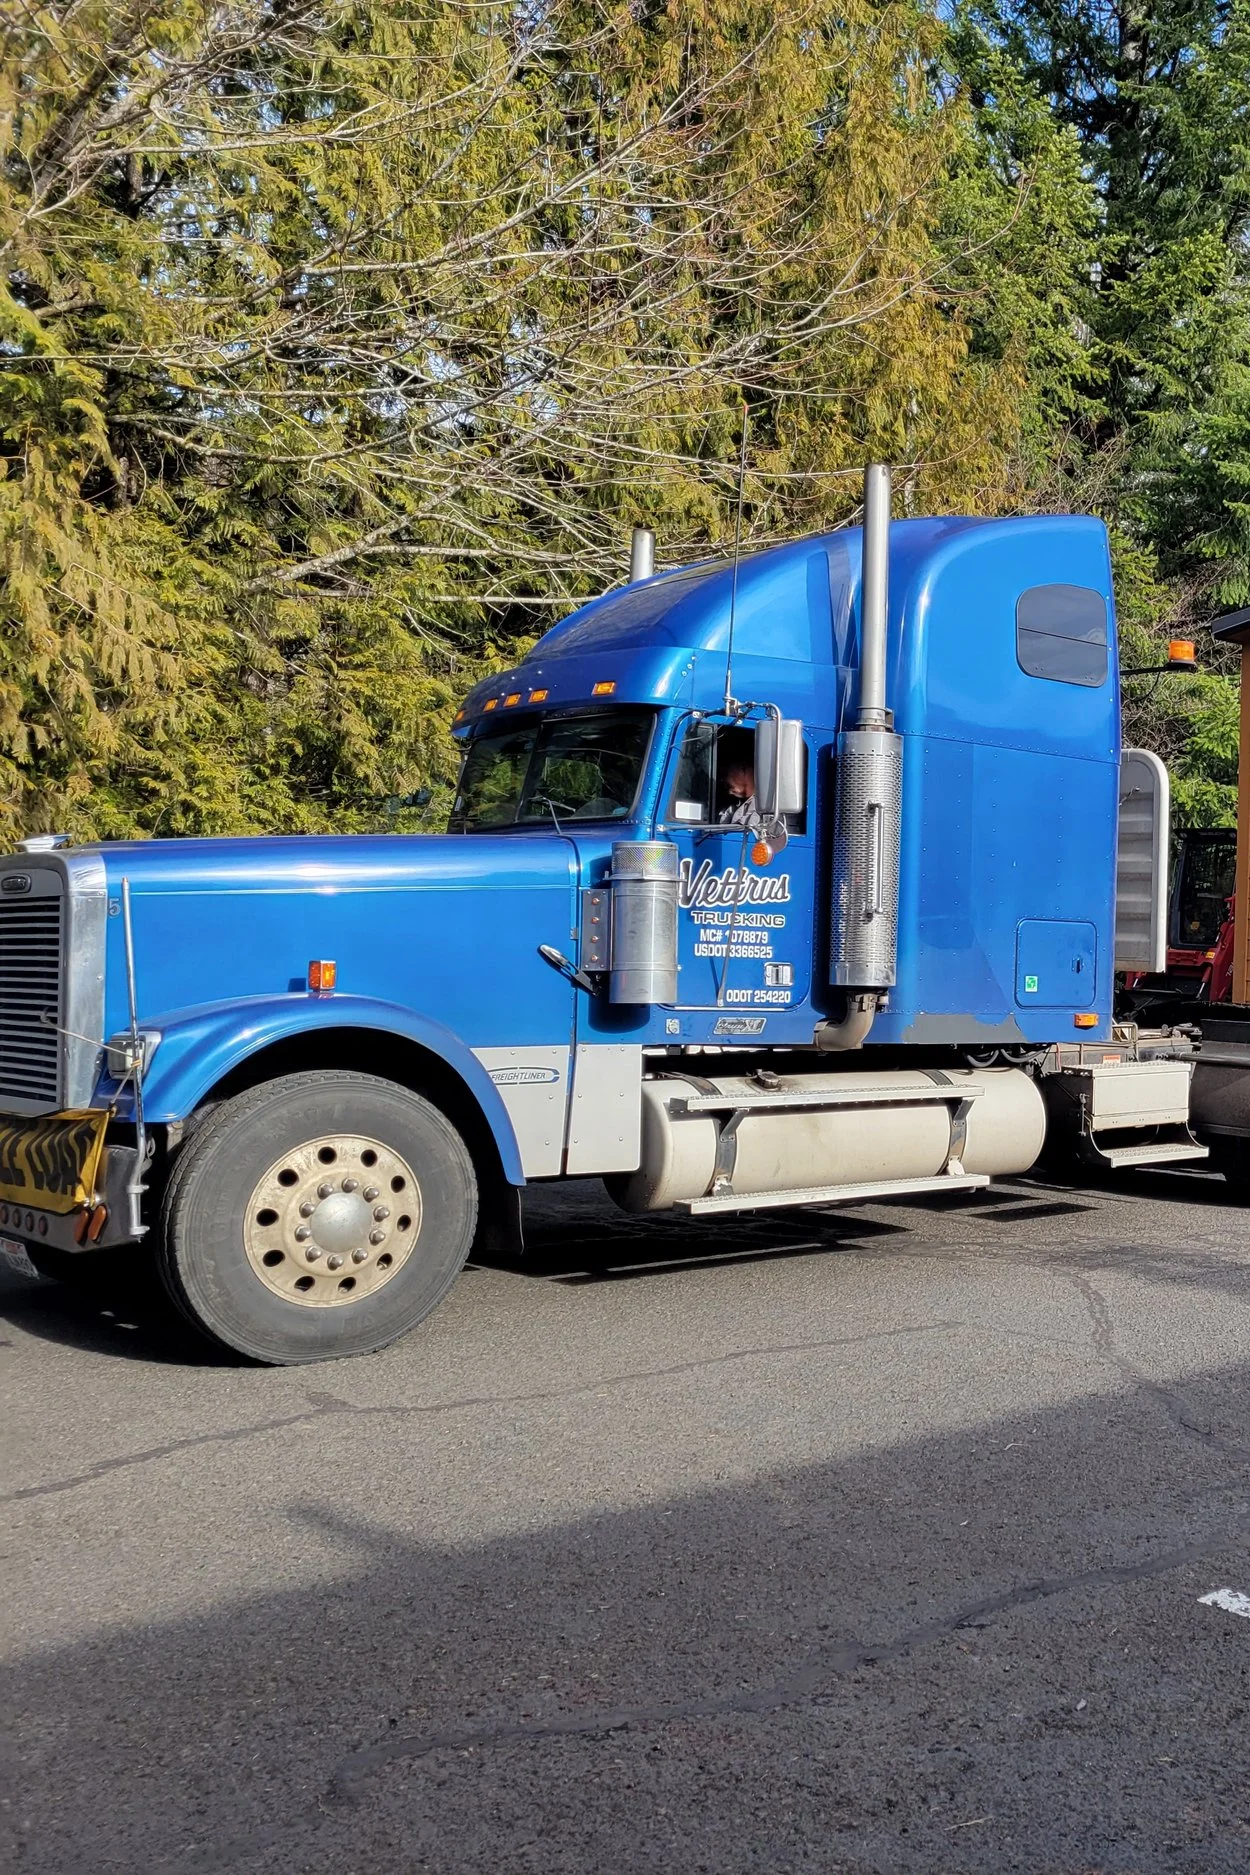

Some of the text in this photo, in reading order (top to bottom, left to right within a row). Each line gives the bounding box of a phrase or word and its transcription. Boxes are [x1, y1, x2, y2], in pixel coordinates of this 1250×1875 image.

[679, 858, 790, 908] Vettrus
[691, 910, 785, 928] TRUCKING
[700, 929, 723, 942] MC#
[694, 944, 772, 958] USDOT 3366525
[726, 990, 791, 1003] ODOT 254220
[491, 1072, 546, 1081] FREIGHTLINER
